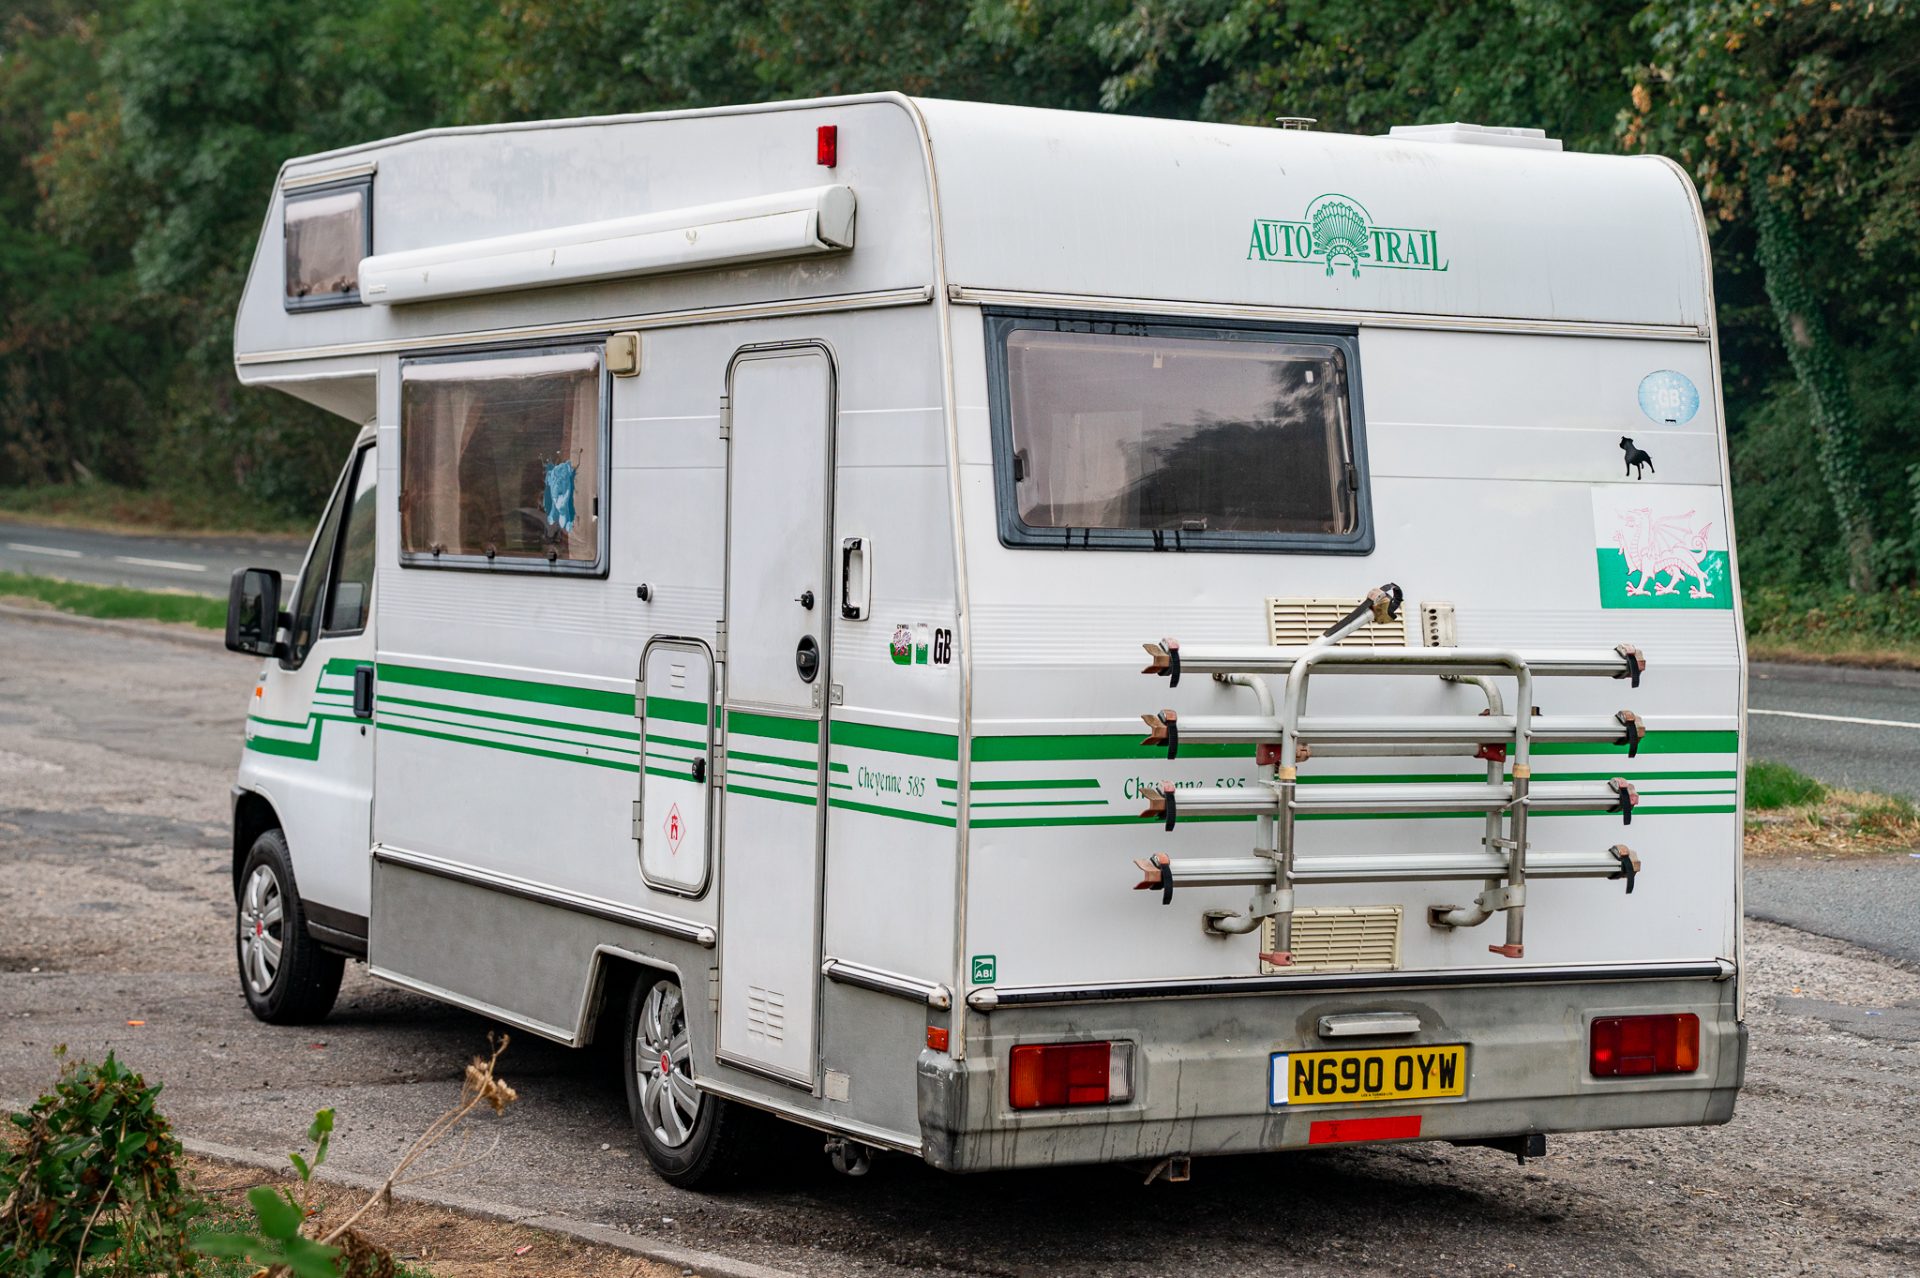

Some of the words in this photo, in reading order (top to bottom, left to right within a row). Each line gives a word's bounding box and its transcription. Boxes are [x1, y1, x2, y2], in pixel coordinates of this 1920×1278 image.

[1247, 219, 1312, 261] AUTO
[1369, 230, 1449, 271] TRAIL
[1659, 389, 1680, 407] GB
[934, 628, 951, 664] GB
[858, 766, 901, 796] Cheyenne
[906, 776, 925, 797] 585
[976, 969, 992, 978] ABI
[1294, 1057, 1384, 1096] N690
[1395, 1053, 1457, 1092] OYW
